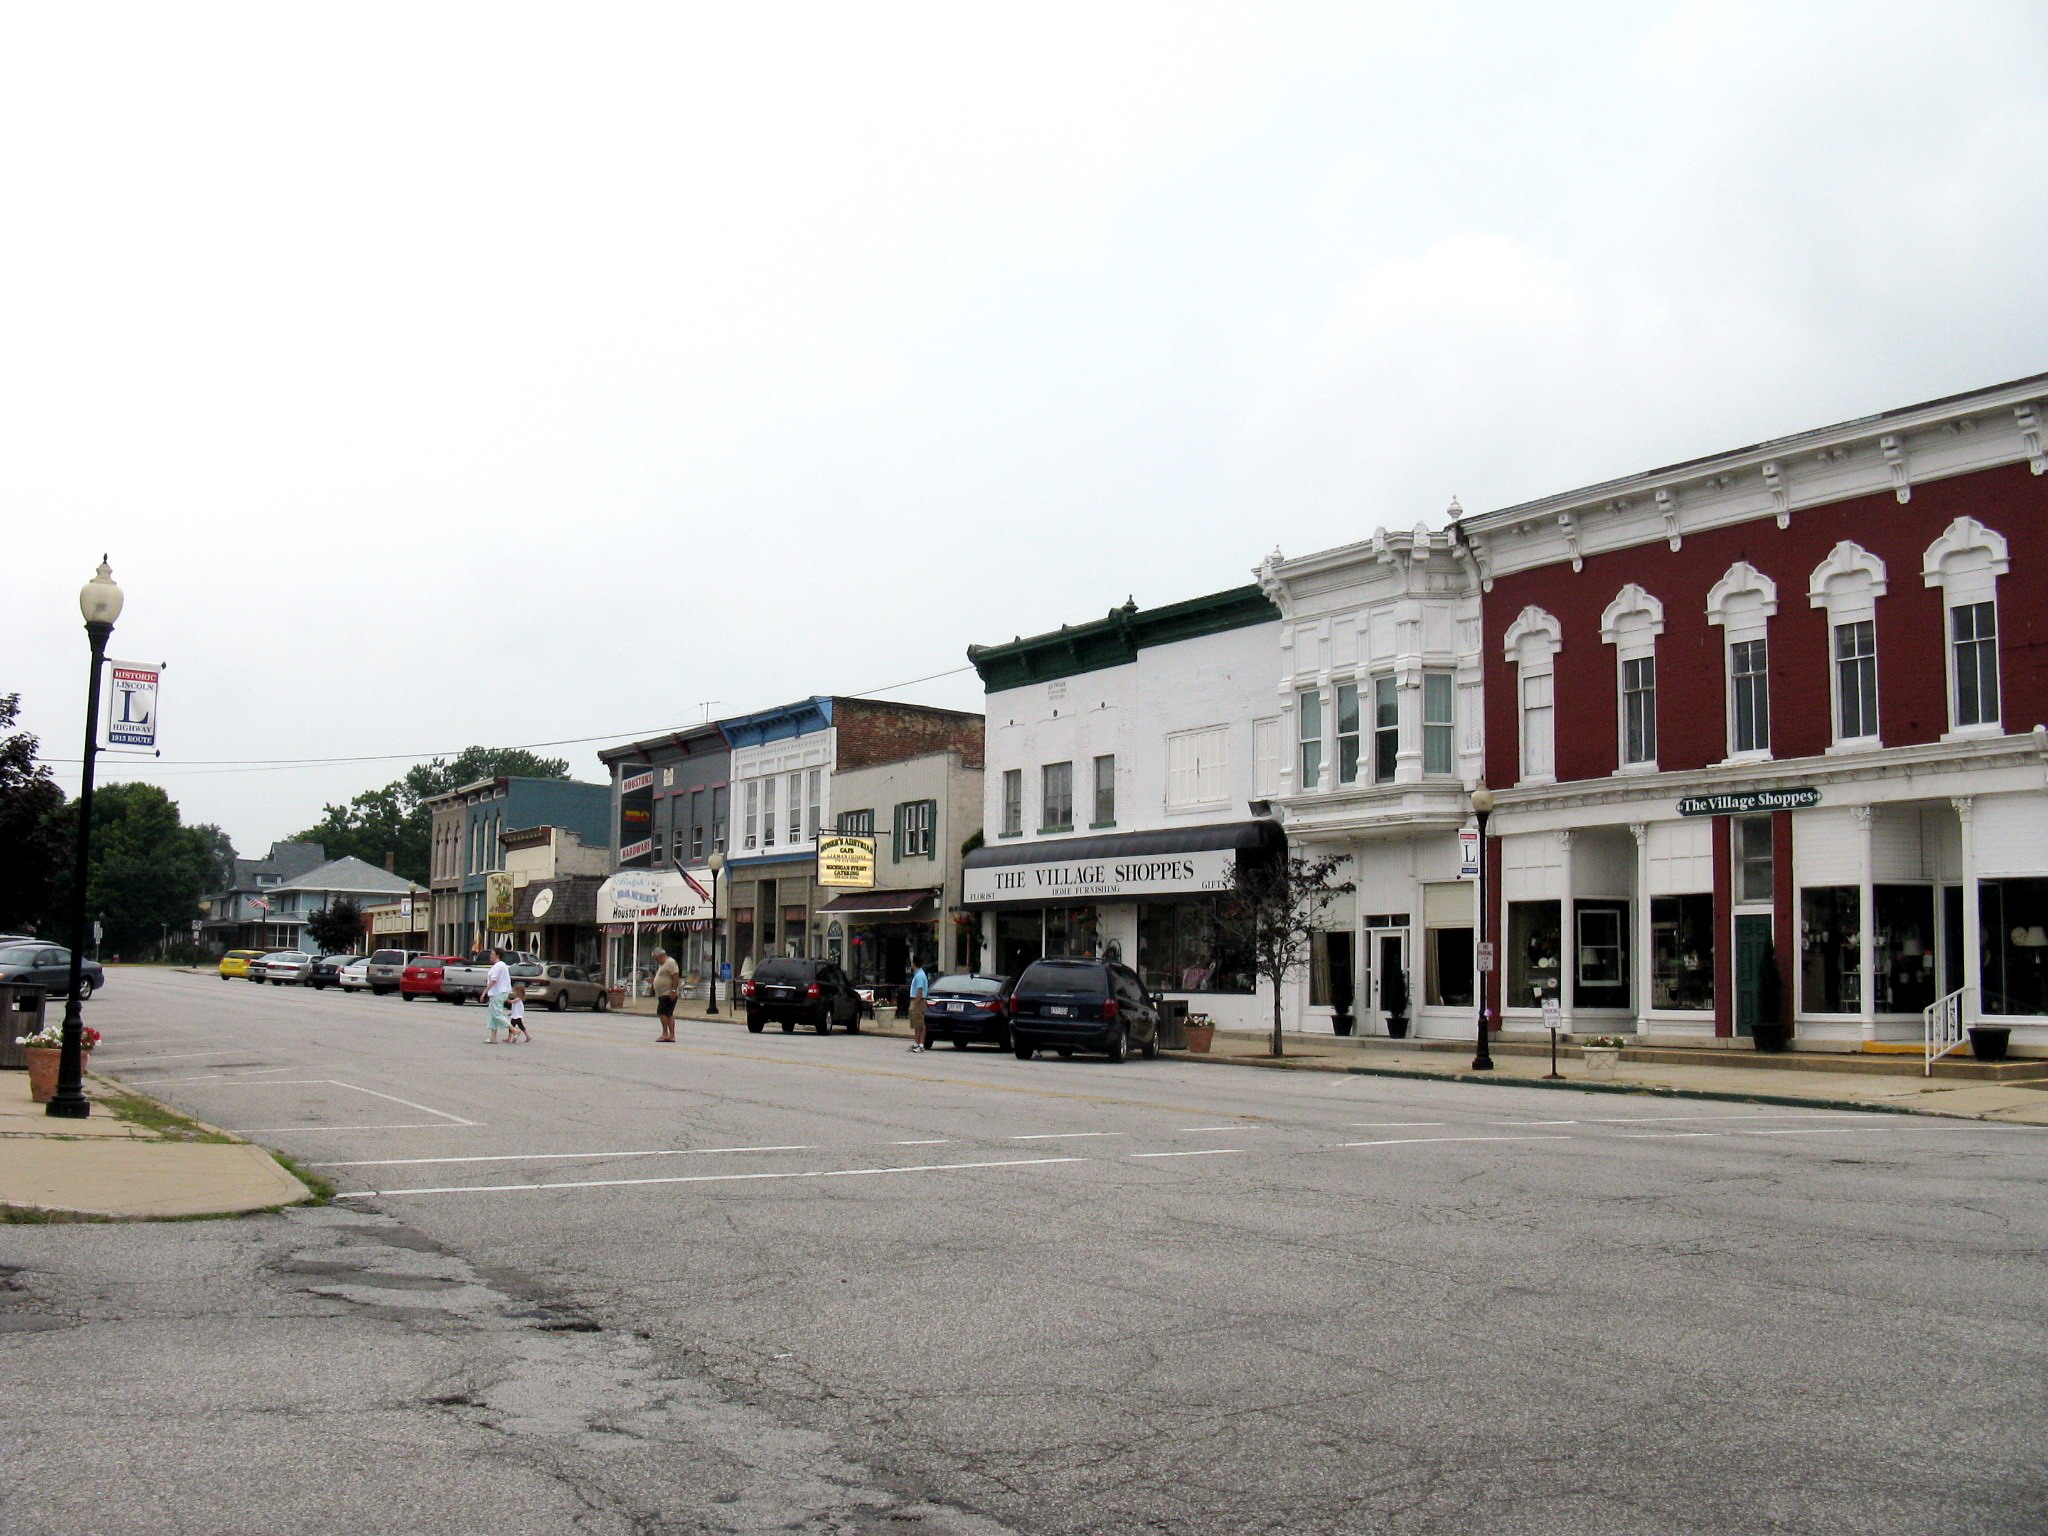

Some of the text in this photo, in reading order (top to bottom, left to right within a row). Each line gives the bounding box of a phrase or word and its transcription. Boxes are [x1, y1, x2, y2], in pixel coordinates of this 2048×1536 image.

[115, 670, 157, 681] HISTORIC
[116, 681, 154, 690] LINCOLN
[117, 689, 149, 724] L
[113, 724, 152, 734] HIGHWAY
[127, 735, 153, 744] ROUTE
[623, 773, 652, 791] HOUSTONS
[1683, 791, 1814, 812] The Village Shoppes
[622, 841, 650, 859] HARDWARE
[1463, 844, 1476, 862] L
[995, 860, 1194, 889] THE VILLAGE SHOPPES
[1052, 885, 1120, 896] HOME FURNISHING
[1201, 880, 1228, 890] GIFTS
[970, 892, 996, 901] FLORIST
[660, 904, 696, 917] Hardware
